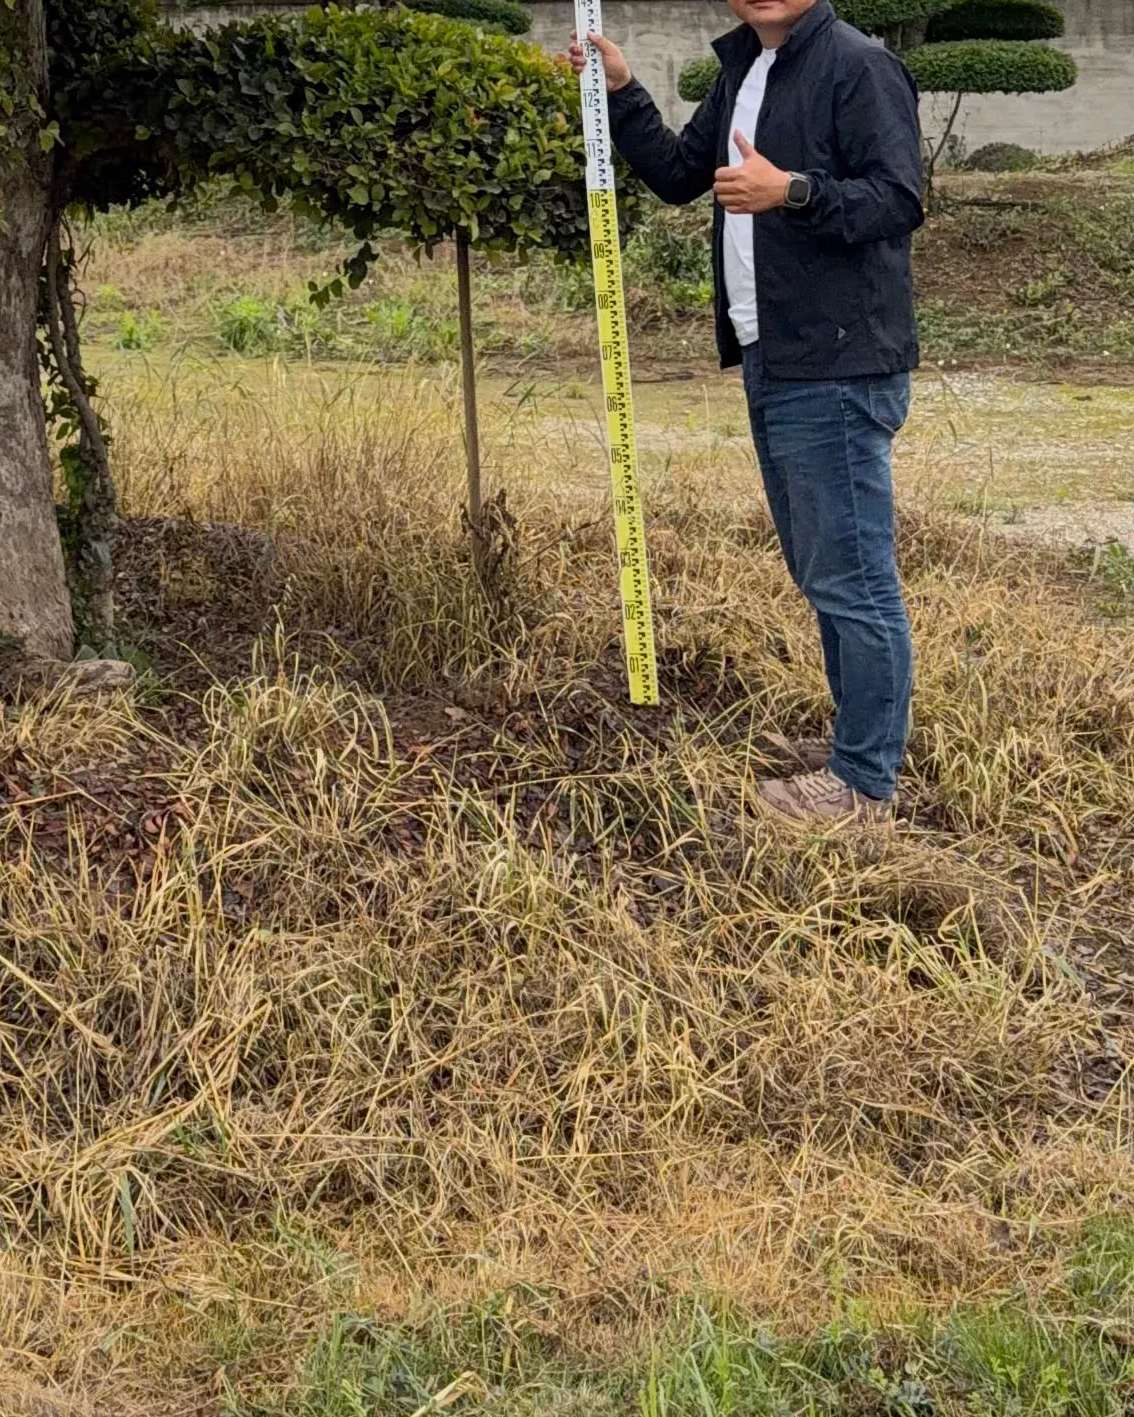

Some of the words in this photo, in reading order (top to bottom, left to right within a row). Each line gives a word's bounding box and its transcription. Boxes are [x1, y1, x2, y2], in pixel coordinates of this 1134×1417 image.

[580, 42, 590, 58] 3
[583, 93, 593, 108] 12
[587, 143, 596, 158] 11
[590, 193, 601, 208] 10
[594, 243, 604, 258] 09
[597, 294, 609, 309] 08
[602, 345, 612, 360] 07
[606, 396, 617, 412] 06
[611, 448, 622, 463] 05
[620, 551, 631, 567] 03
[624, 604, 636, 620] 02
[630, 657, 640, 673] 01
